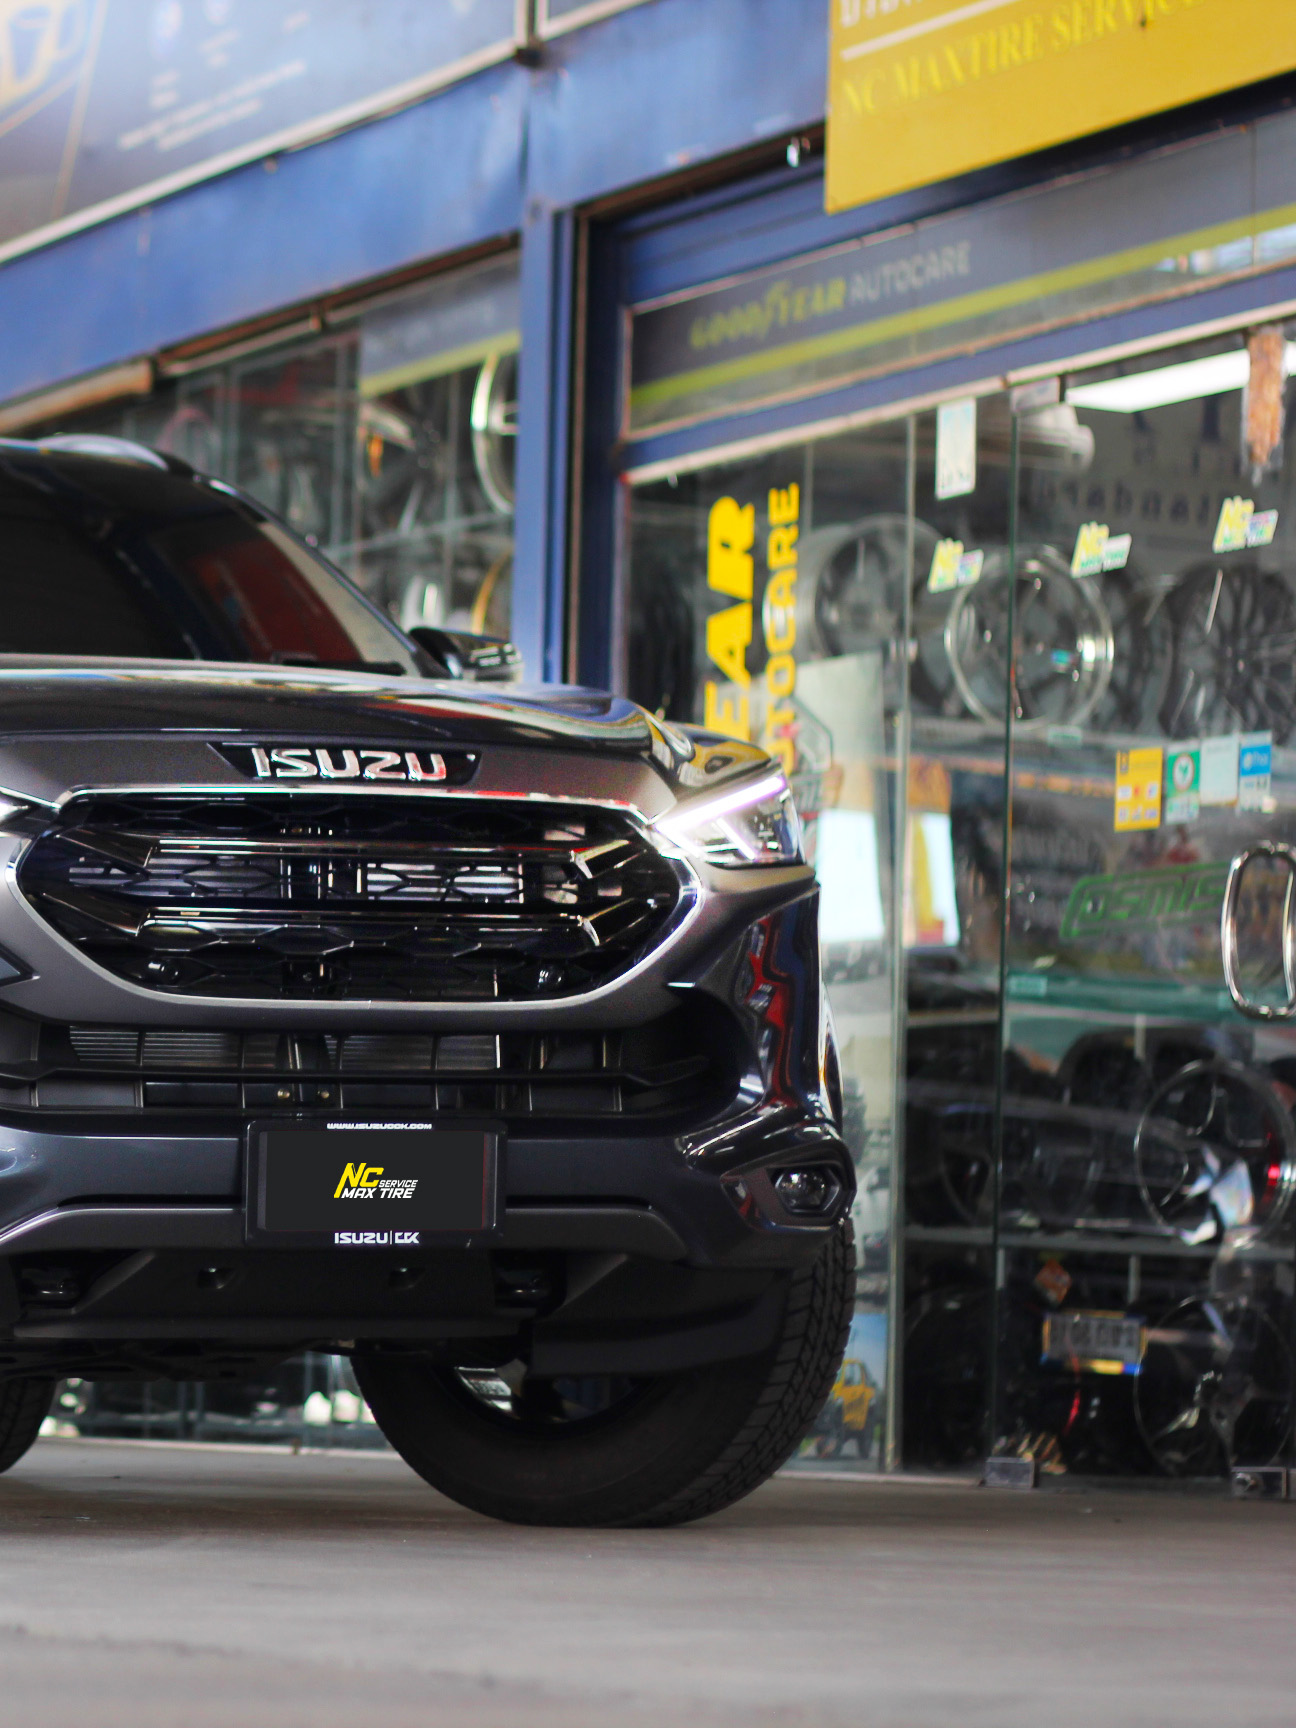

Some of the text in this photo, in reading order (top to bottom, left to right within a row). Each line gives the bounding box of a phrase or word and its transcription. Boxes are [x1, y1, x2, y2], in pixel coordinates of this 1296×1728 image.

[851, 240, 972, 305] AUTOCARE
[251, 747, 447, 781] ISUZU
[334, 1232, 388, 1244] ISUZU
